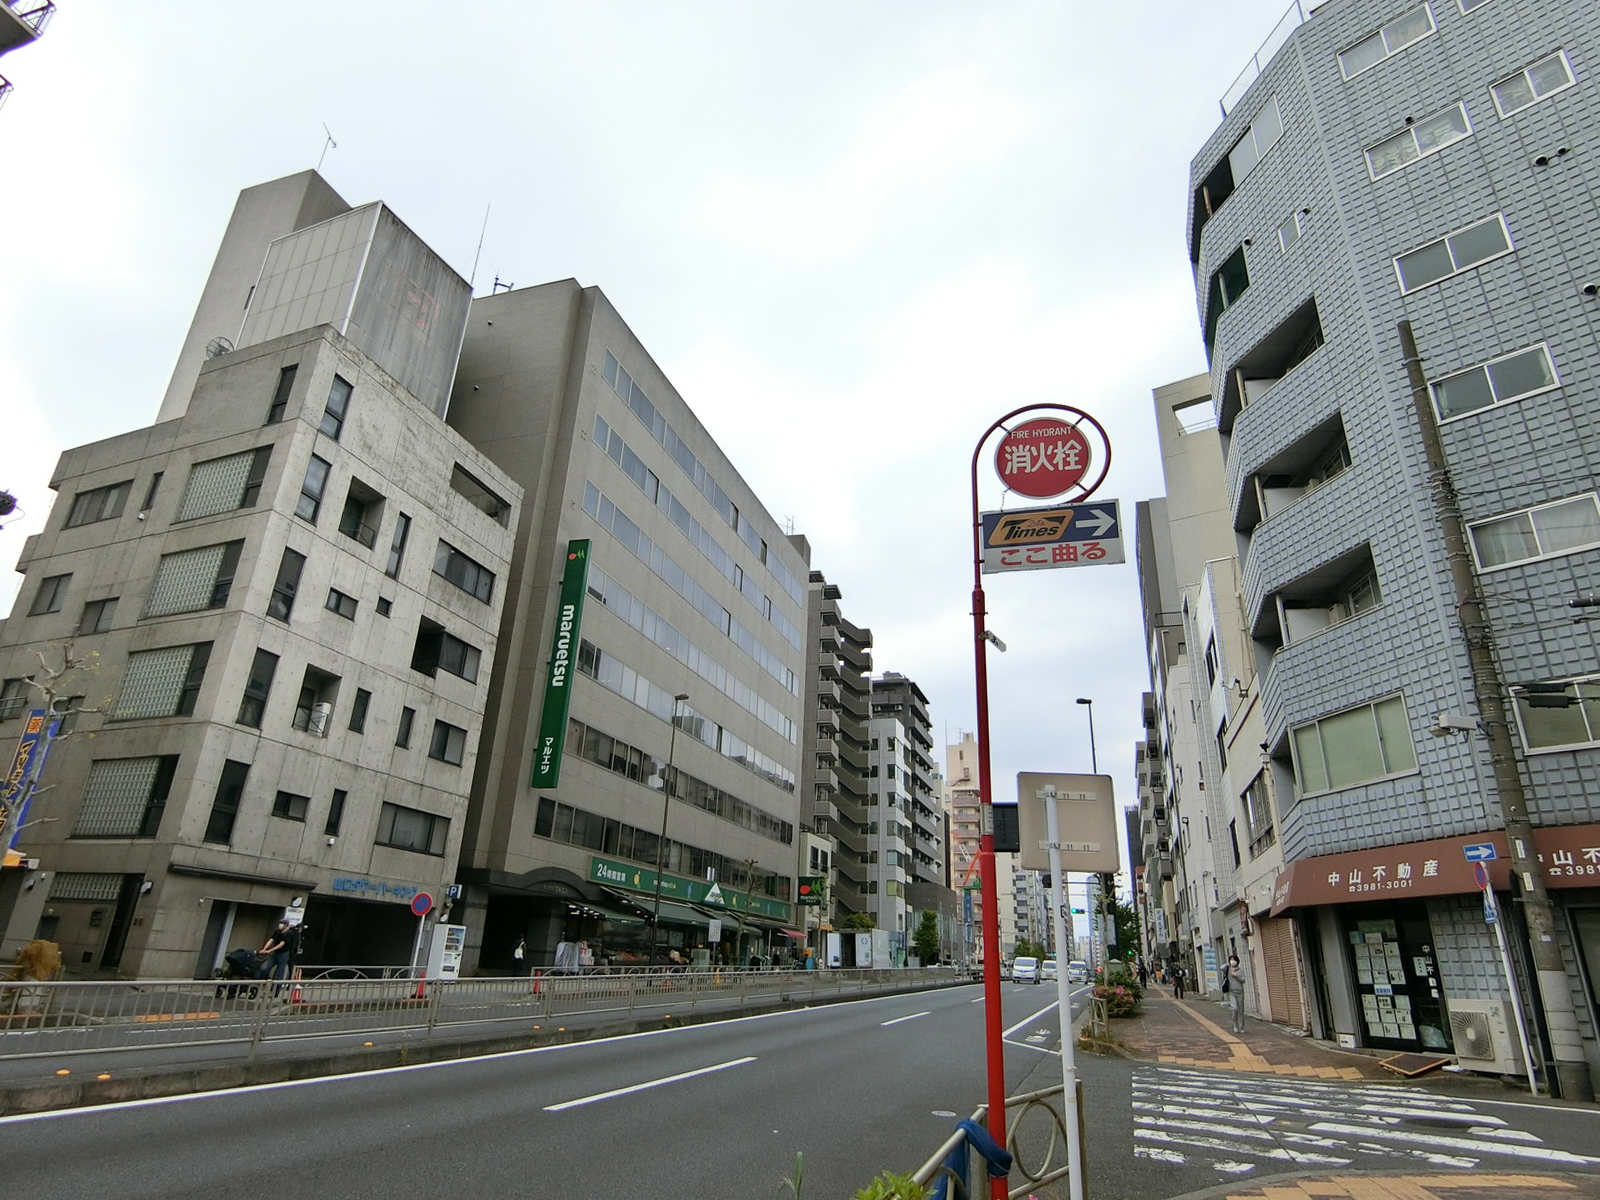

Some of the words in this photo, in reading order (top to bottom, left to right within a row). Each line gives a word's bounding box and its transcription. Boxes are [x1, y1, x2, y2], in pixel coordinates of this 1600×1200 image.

[1010, 429, 1030, 440] FIRE
[1032, 427, 1072, 438] HYDRANT
[1004, 439, 1082, 475] 消火栓
[1003, 517, 1062, 541] Times
[1000, 541, 1106, 566] ここ曲る
[551, 604, 575, 687] maruetsu
[540, 736, 554, 774] マルエツ
[1328, 860, 1438, 887] 中山不動産
[1356, 879, 1412, 892] 3981-3001
